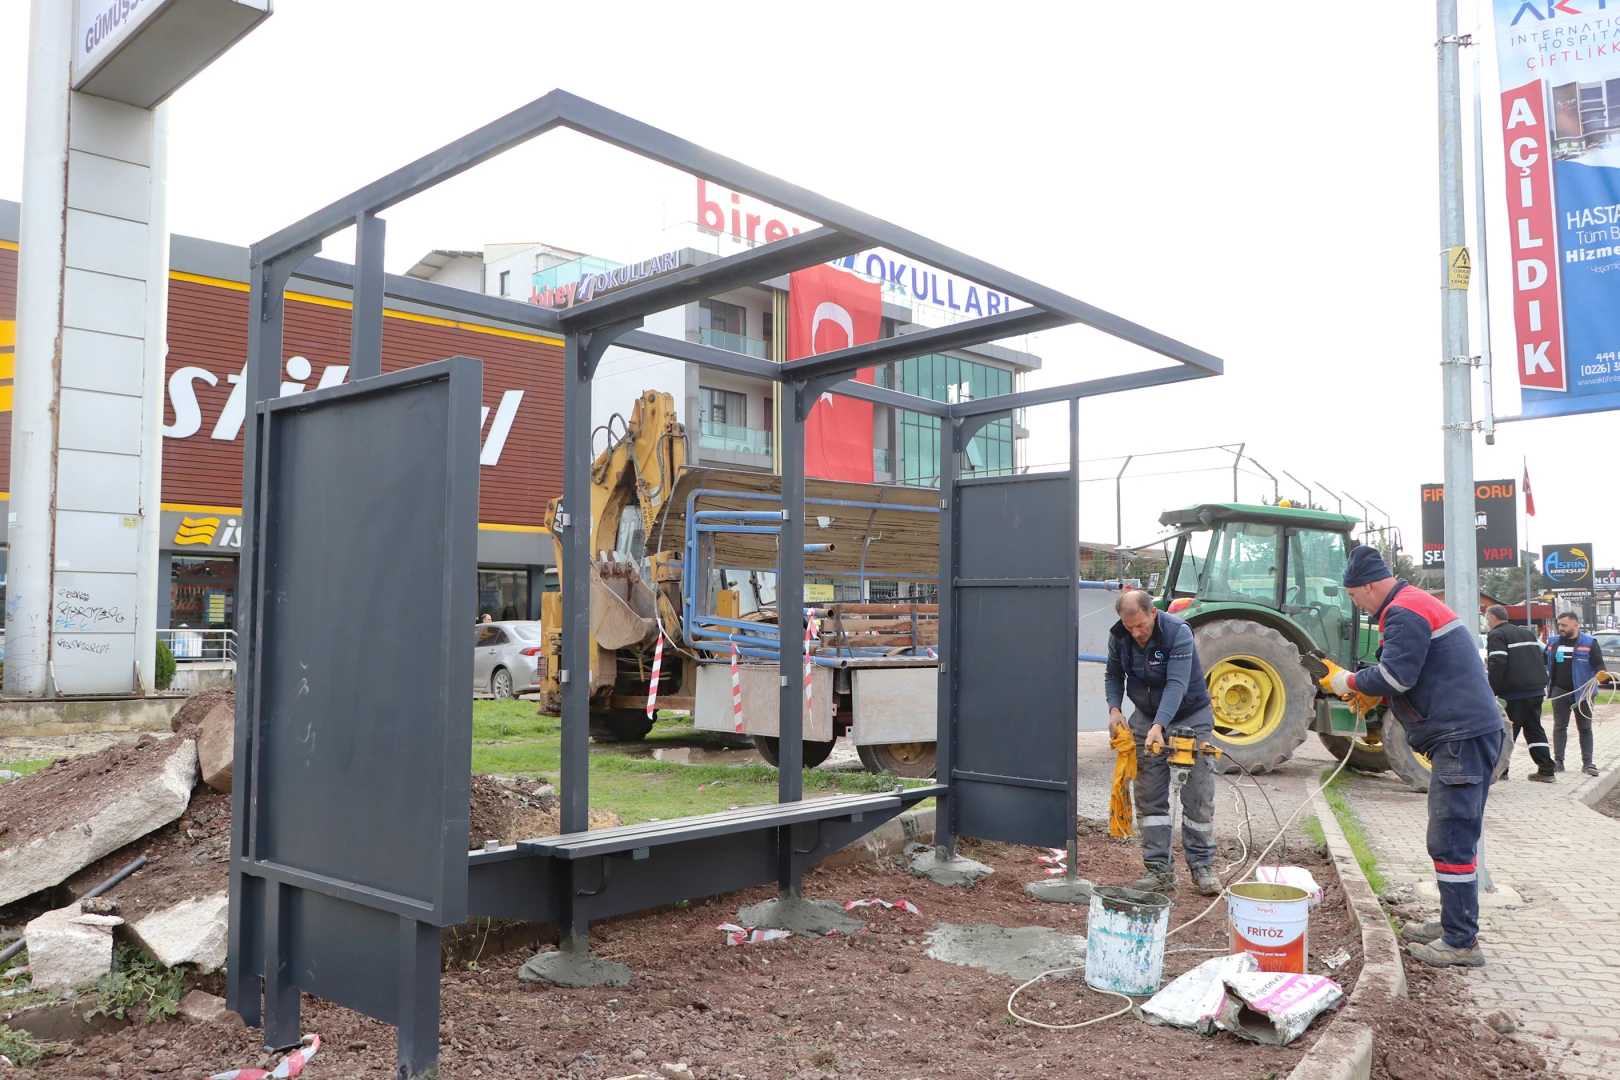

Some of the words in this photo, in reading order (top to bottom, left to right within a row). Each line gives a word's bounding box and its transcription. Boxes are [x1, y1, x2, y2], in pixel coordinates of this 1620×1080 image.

[1575, 230, 1607, 245] Tüm
[532, 284, 578, 308] birey
[594, 249, 681, 292] OKULLARI
[1595, 351, 1615, 362] 444
[1482, 547, 1513, 561] YAPI
[1247, 925, 1284, 939] FRİTÖZ
